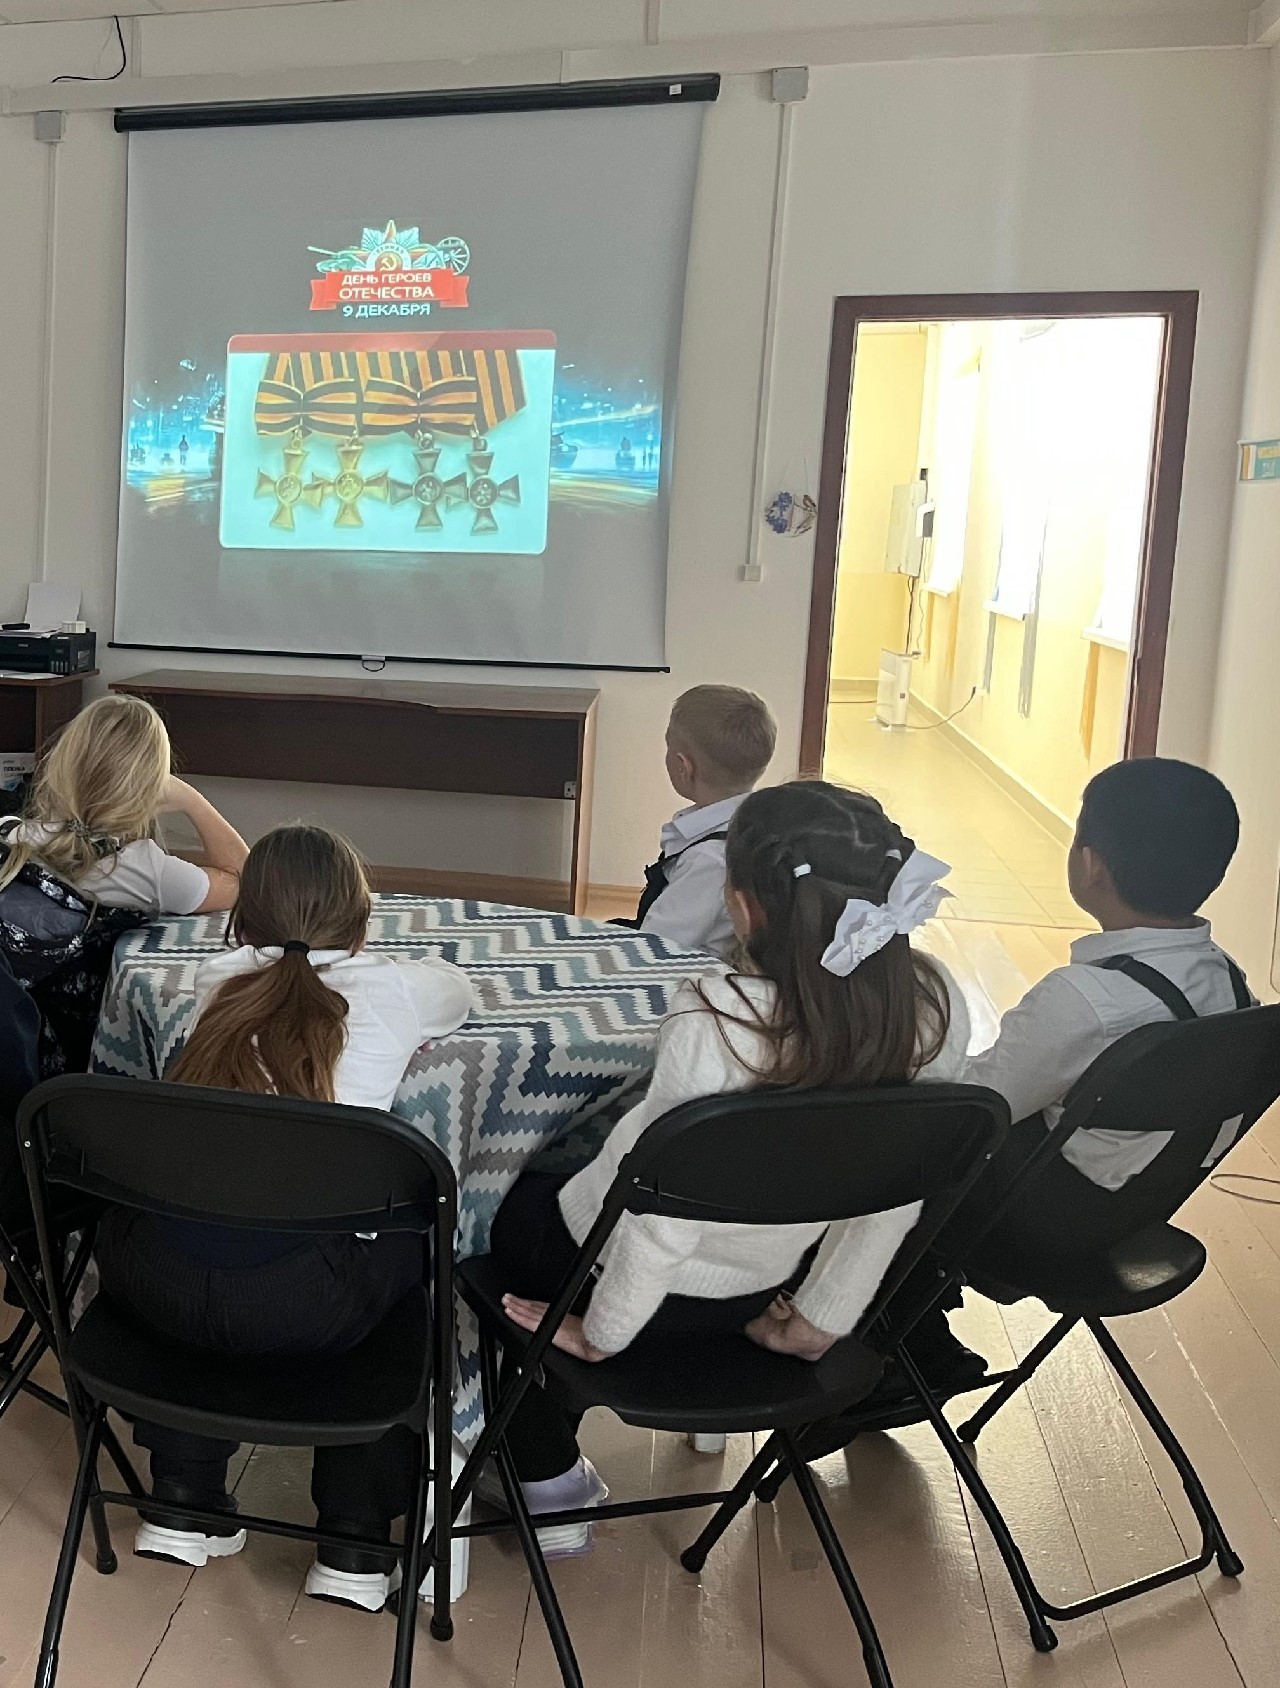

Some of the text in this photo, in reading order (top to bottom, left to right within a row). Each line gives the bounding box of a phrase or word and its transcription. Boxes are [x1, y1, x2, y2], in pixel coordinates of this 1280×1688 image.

[341, 272, 432, 287] ДЕНЬ ГЕРОЕВ
[338, 285, 435, 300] ОТЕЧЕСТВА
[342, 302, 432, 319] 9 ДЕКАБРЯ
